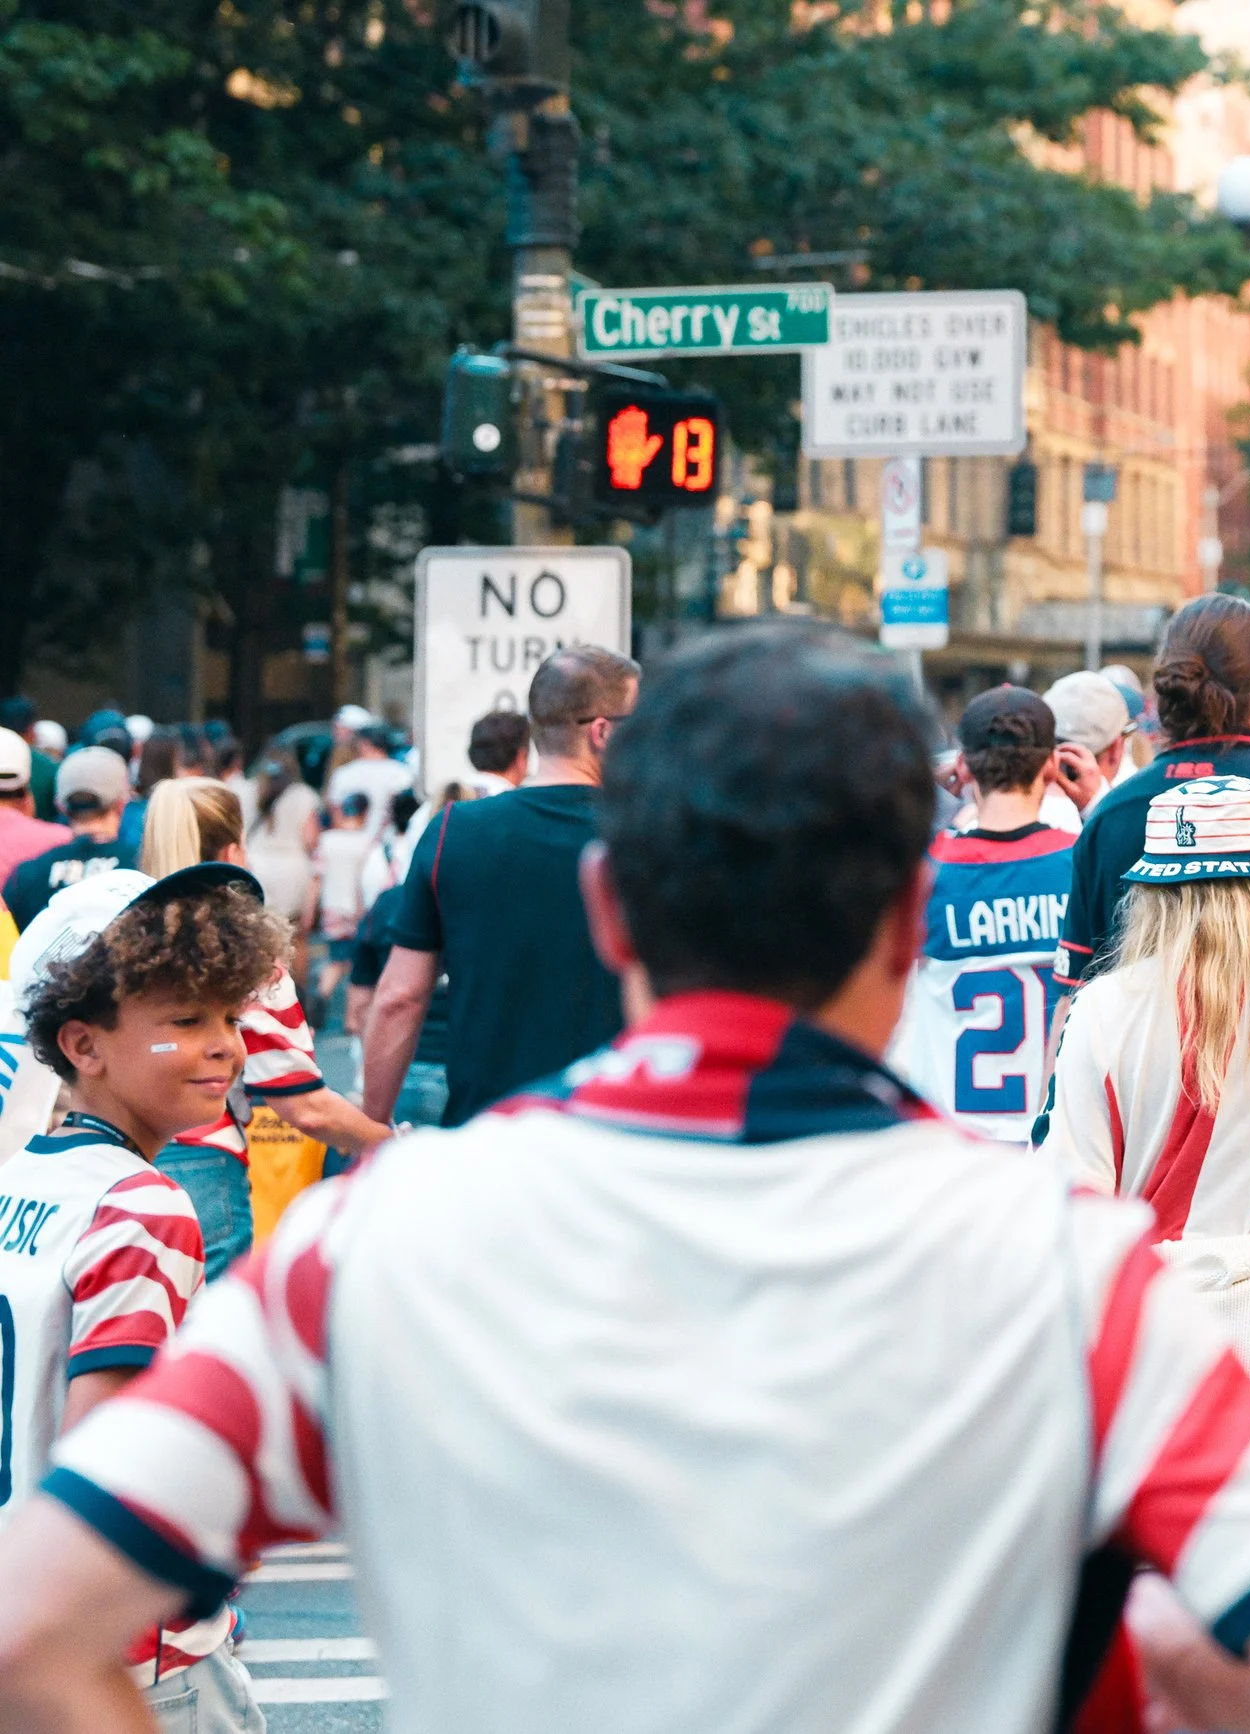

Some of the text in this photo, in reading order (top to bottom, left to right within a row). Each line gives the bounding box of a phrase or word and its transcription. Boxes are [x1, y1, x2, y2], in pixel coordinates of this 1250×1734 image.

[592, 298, 740, 351] Cherry
[837, 312, 931, 340] EHICLES
[890, 377, 936, 403] NOT
[950, 375, 995, 402] USE
[845, 411, 978, 437] CURB LANE
[672, 417, 715, 492] 13
[480, 571, 566, 618] NO
[466, 635, 580, 674] TUR
[945, 893, 1069, 948] LARKIN
